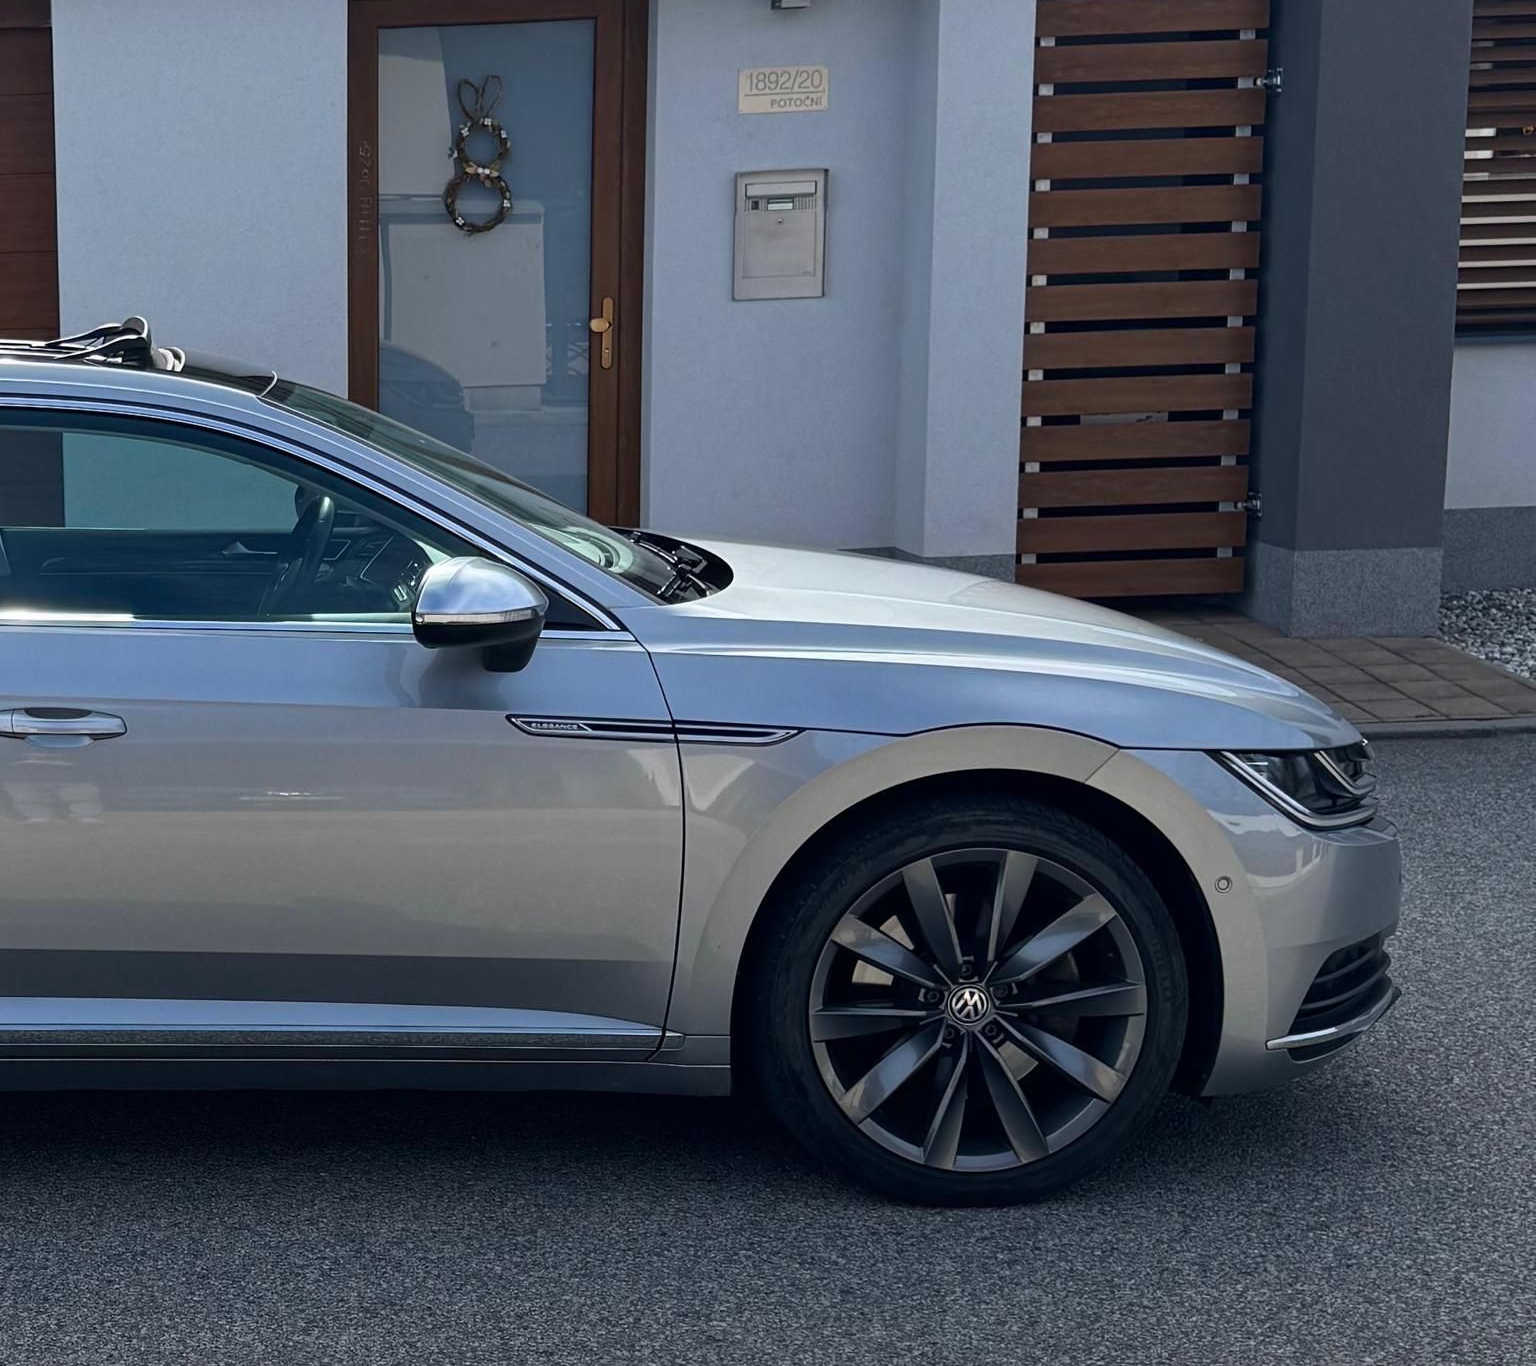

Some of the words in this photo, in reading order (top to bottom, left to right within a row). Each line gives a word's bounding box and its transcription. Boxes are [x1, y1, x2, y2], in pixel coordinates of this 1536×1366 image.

[747, 69, 823, 92] 1892/20
[770, 95, 823, 109] POTOČNÍ
[530, 722, 578, 730] ELEGANCE
